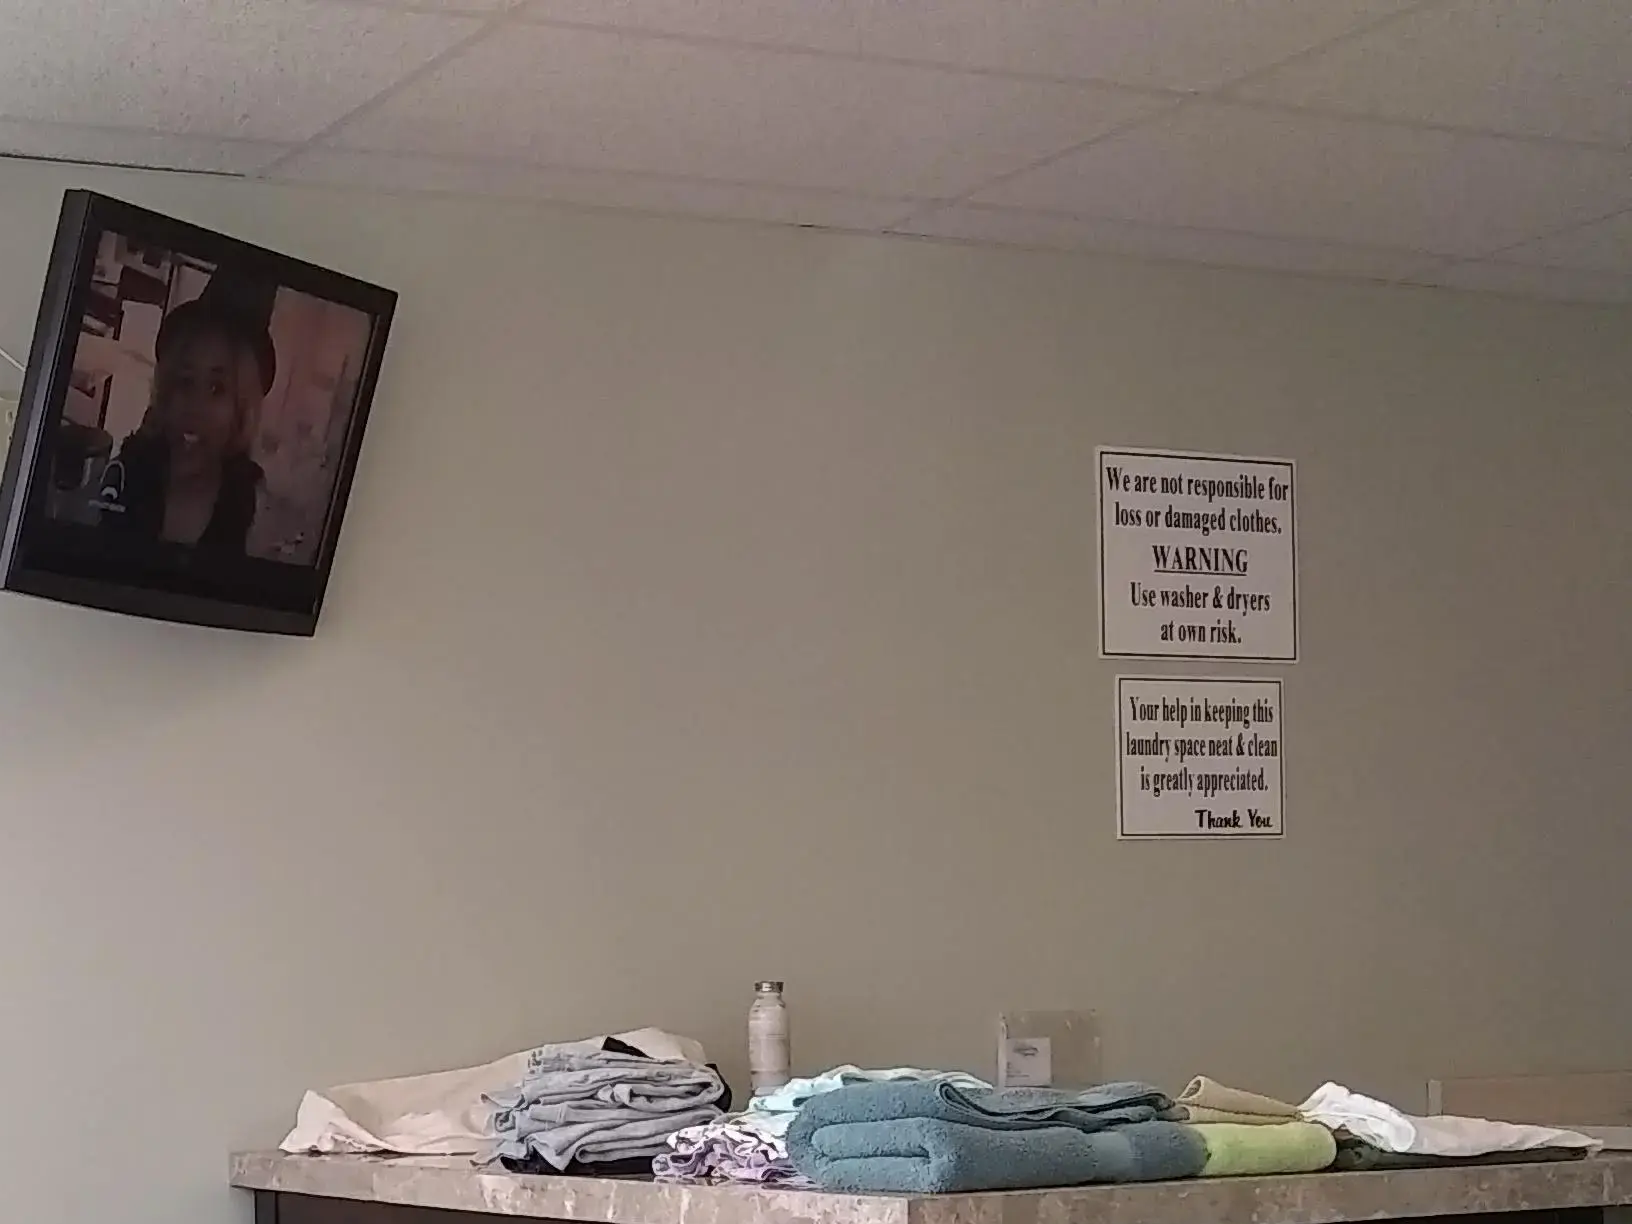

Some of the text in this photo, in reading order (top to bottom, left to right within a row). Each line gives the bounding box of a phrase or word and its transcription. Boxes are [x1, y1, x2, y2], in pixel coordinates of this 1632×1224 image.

[1106, 467, 1288, 502] We are not responsible for
[1115, 502, 1282, 536] loss or damaged clothes.
[1152, 545, 1248, 573] WARNING
[1131, 582, 1270, 616] Use washer & dryers
[1161, 619, 1242, 644] at own risk.
[1130, 697, 1274, 729] Your help in keeping this
[1126, 732, 1277, 762] laundry space neat & clean
[1141, 766, 1268, 797] is greatly appreciated.
[1194, 809, 1273, 829] Thank You
